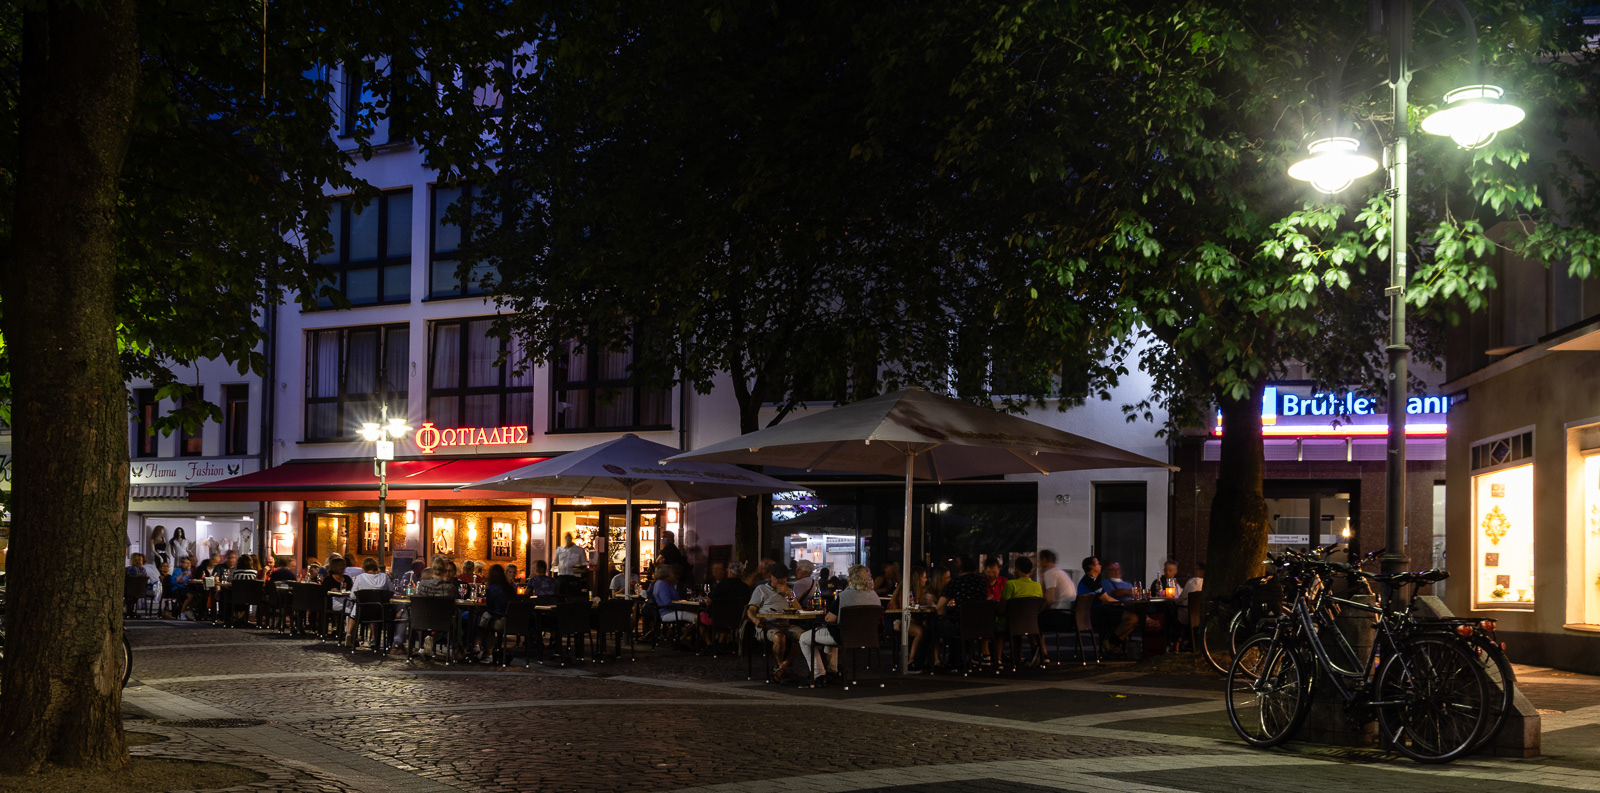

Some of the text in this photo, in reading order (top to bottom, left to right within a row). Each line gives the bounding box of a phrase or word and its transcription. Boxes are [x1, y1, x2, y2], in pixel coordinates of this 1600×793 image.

[415, 422, 528, 454] ΦΩΤΙΑΔΗΣ
[145, 461, 224, 480] Huma Fashion
